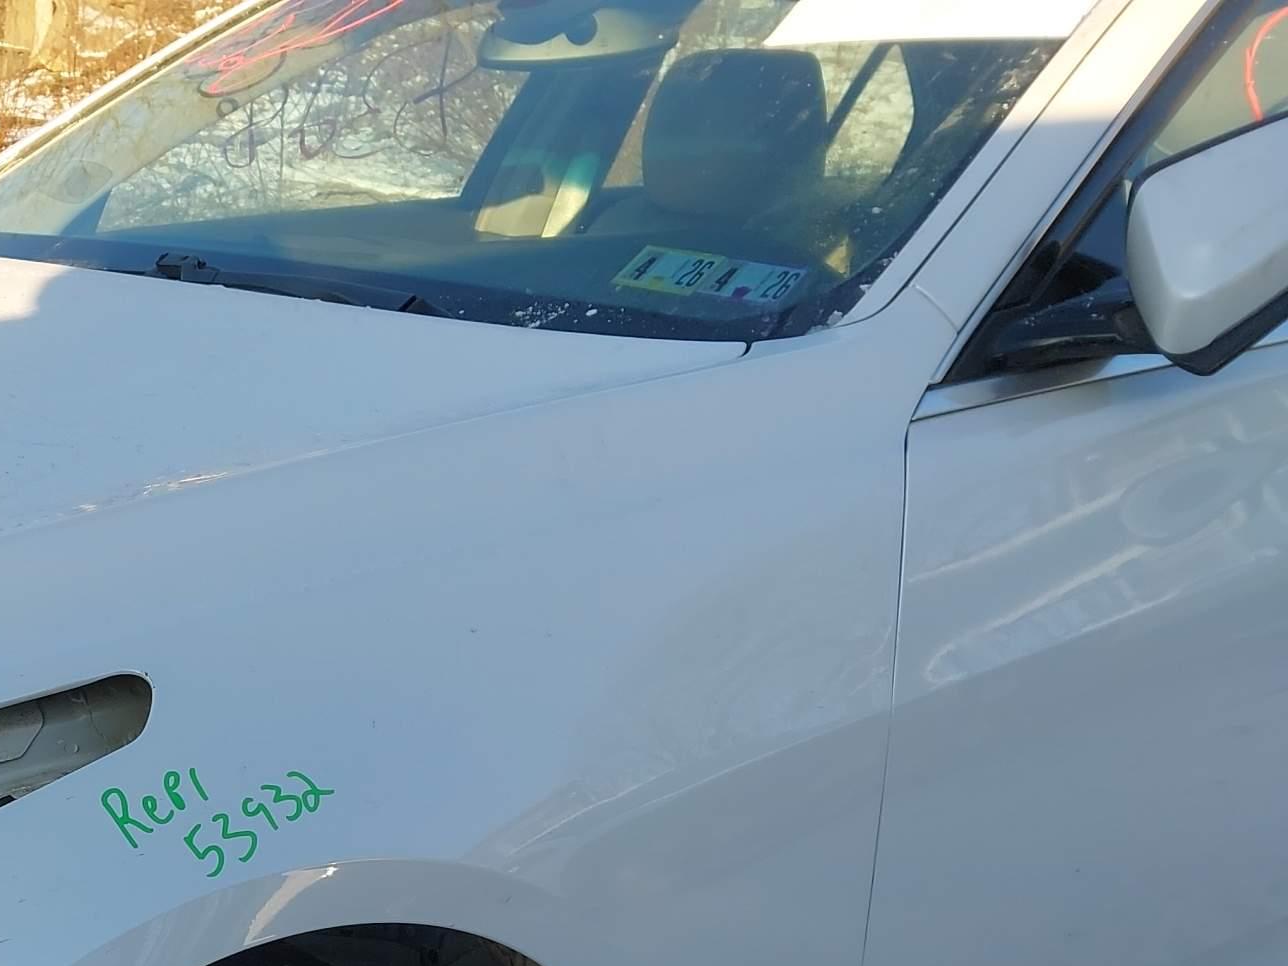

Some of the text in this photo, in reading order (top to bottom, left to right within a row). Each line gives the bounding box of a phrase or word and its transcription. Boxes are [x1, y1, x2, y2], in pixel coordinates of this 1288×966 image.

[632, 256, 715, 288] 4 26
[712, 267, 800, 300] 4 26
[183, 770, 335, 878] 53932
